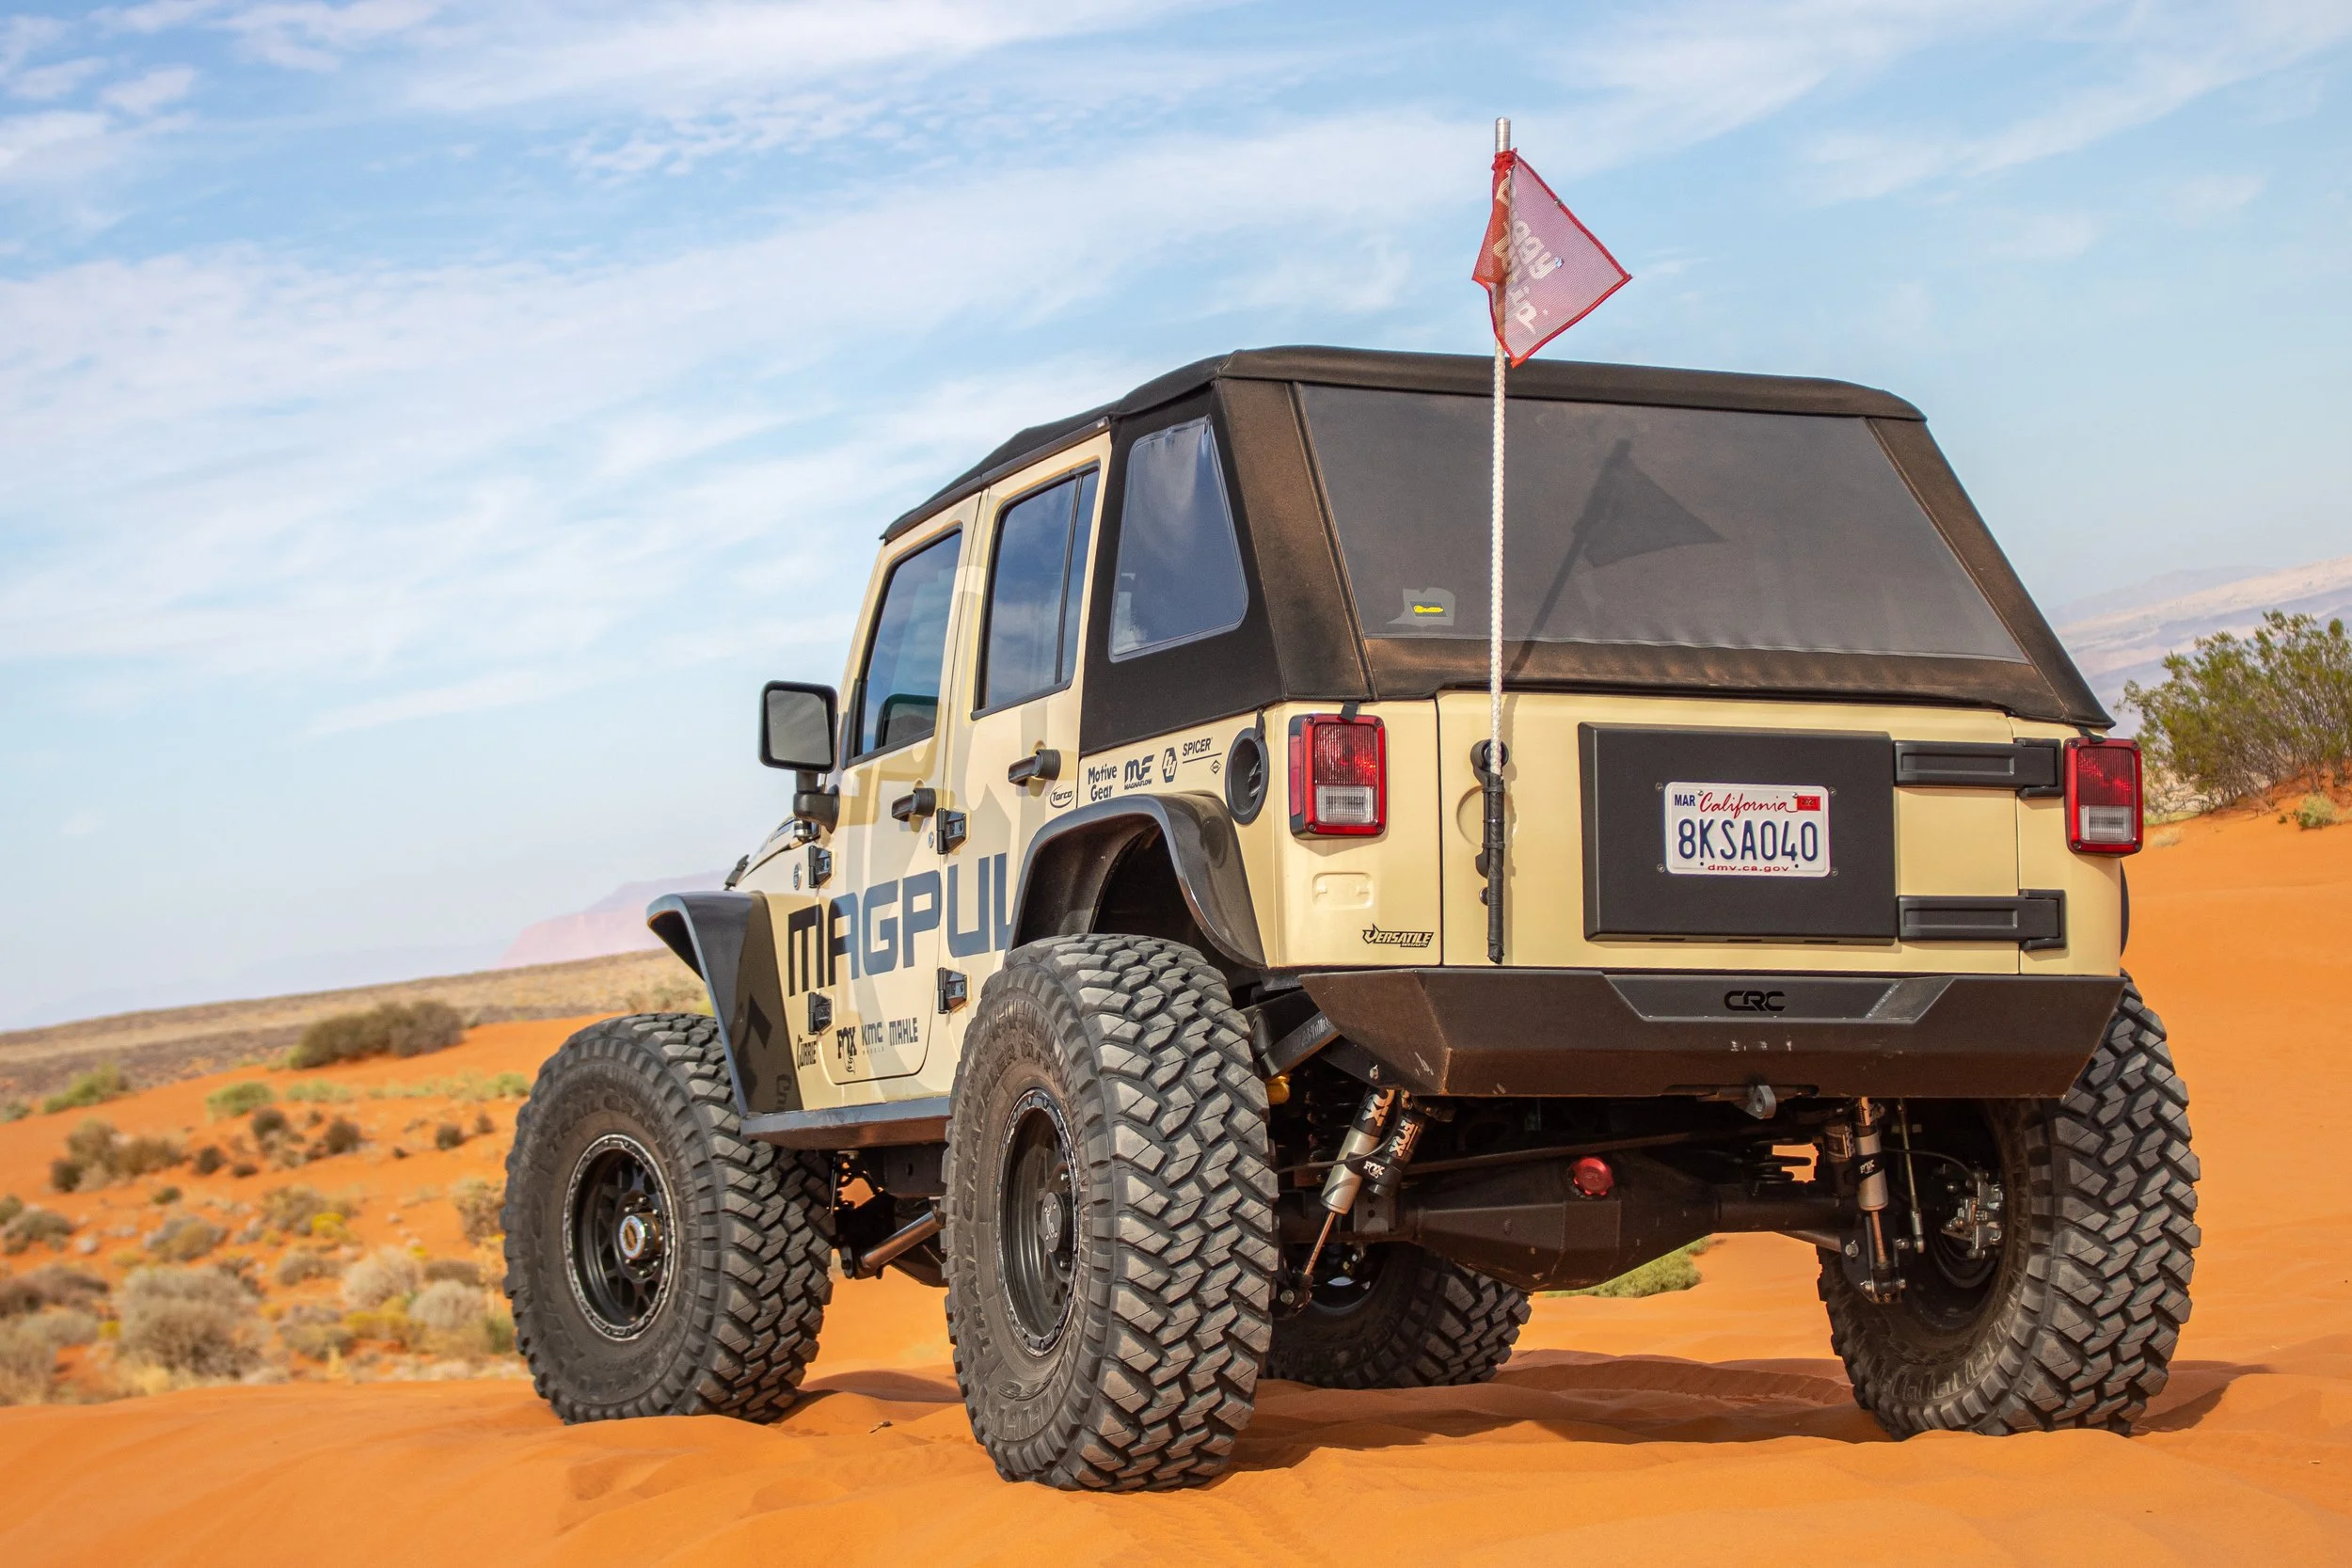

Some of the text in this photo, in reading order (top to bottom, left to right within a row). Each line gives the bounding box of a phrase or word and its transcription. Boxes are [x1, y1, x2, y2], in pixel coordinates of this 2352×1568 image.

[1183, 738, 1212, 756] SPICER
[1088, 763, 1118, 784] Motive
[1090, 784, 1114, 801] Gear
[1124, 778, 1152, 790] MAGNAFLOW
[1051, 787, 1073, 802] Torco
[1675, 794, 1695, 807] MAR
[1699, 792, 1798, 819] California
[1678, 818, 1818, 862] 8KSA040
[1708, 863, 1789, 873] dmv.ca.gov
[787, 852, 1011, 997] MAGPUL
[1363, 924, 1432, 943] VERSATILE
[1724, 990, 1786, 1011] CRC
[861, 1022, 883, 1046] KMC
[889, 1018, 918, 1046] MAHLE
[1388, 1119, 1416, 1158] FOX
[1363, 1161, 1386, 1179] FOX
